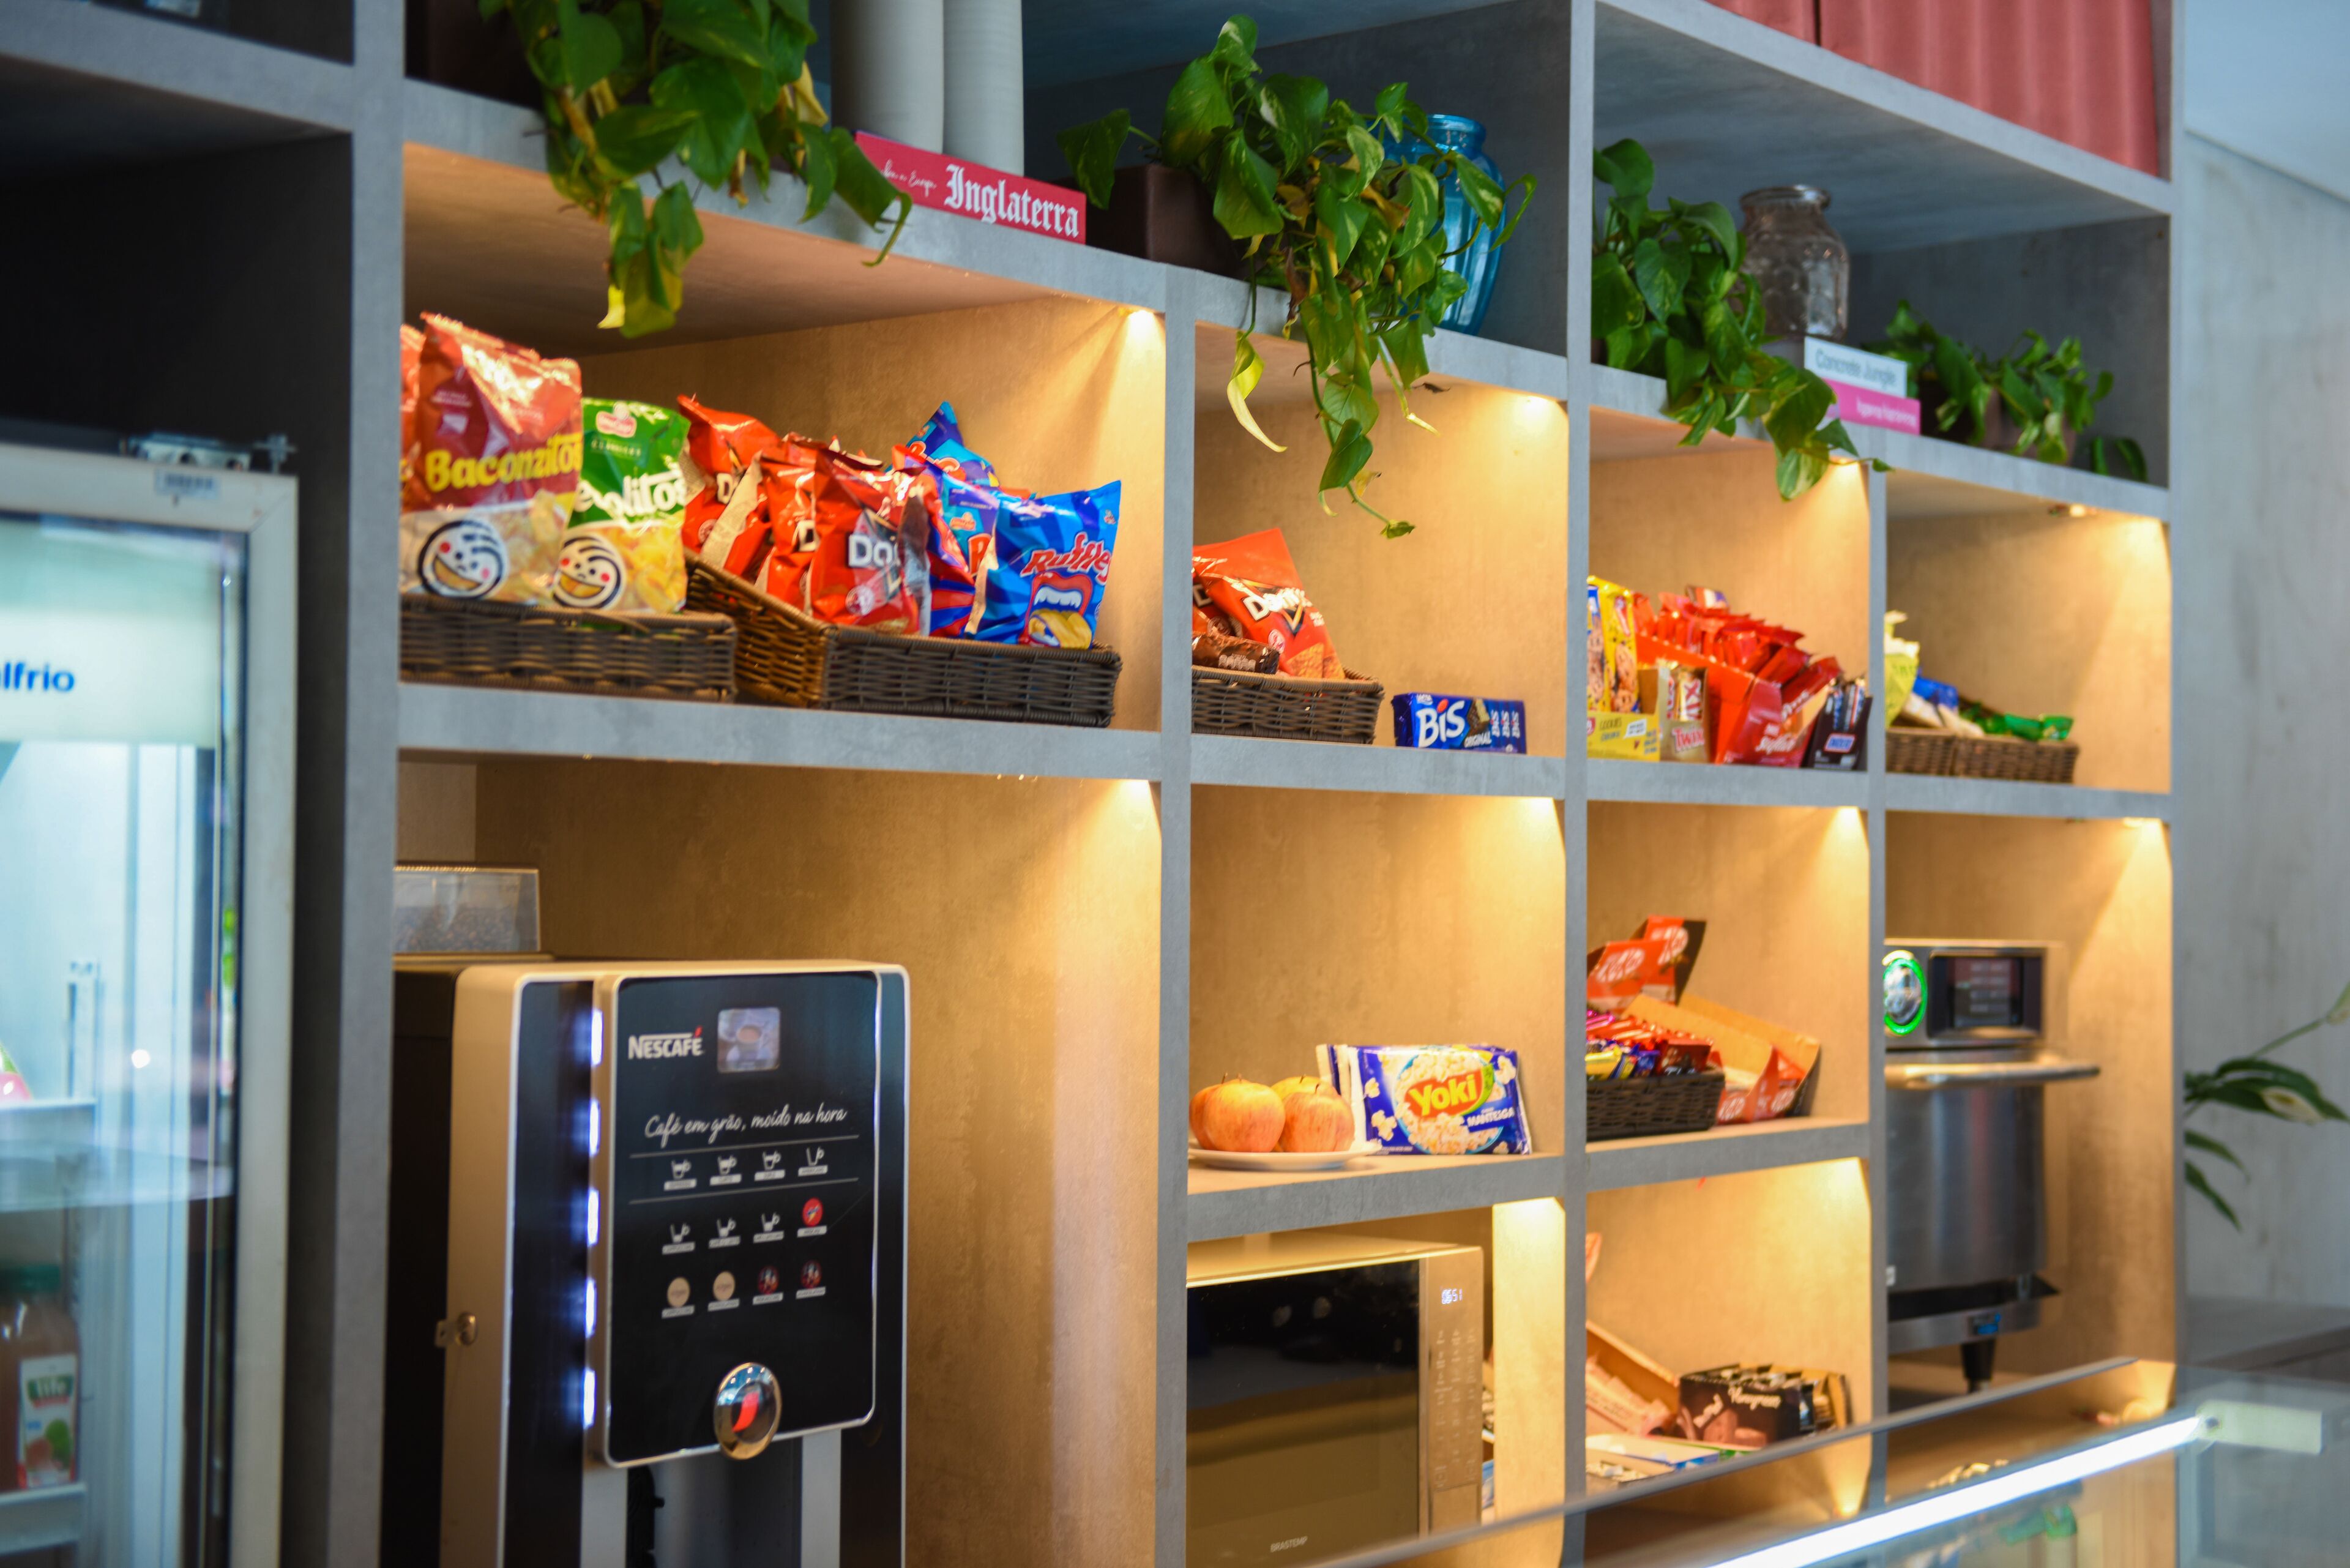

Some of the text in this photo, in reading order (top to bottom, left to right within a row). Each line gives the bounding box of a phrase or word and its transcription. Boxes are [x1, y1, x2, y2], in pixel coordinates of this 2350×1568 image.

[944, 163, 1080, 239] Inglaterra
[0, 661, 75, 692] lfrio
[1409, 1073, 1477, 1116] Yoki
[644, 1112, 684, 1148] Café
[684, 1119, 710, 1133] em
[750, 1103, 791, 1128] moído
[794, 1110, 815, 1125] na
[815, 1102, 848, 1123] hora
